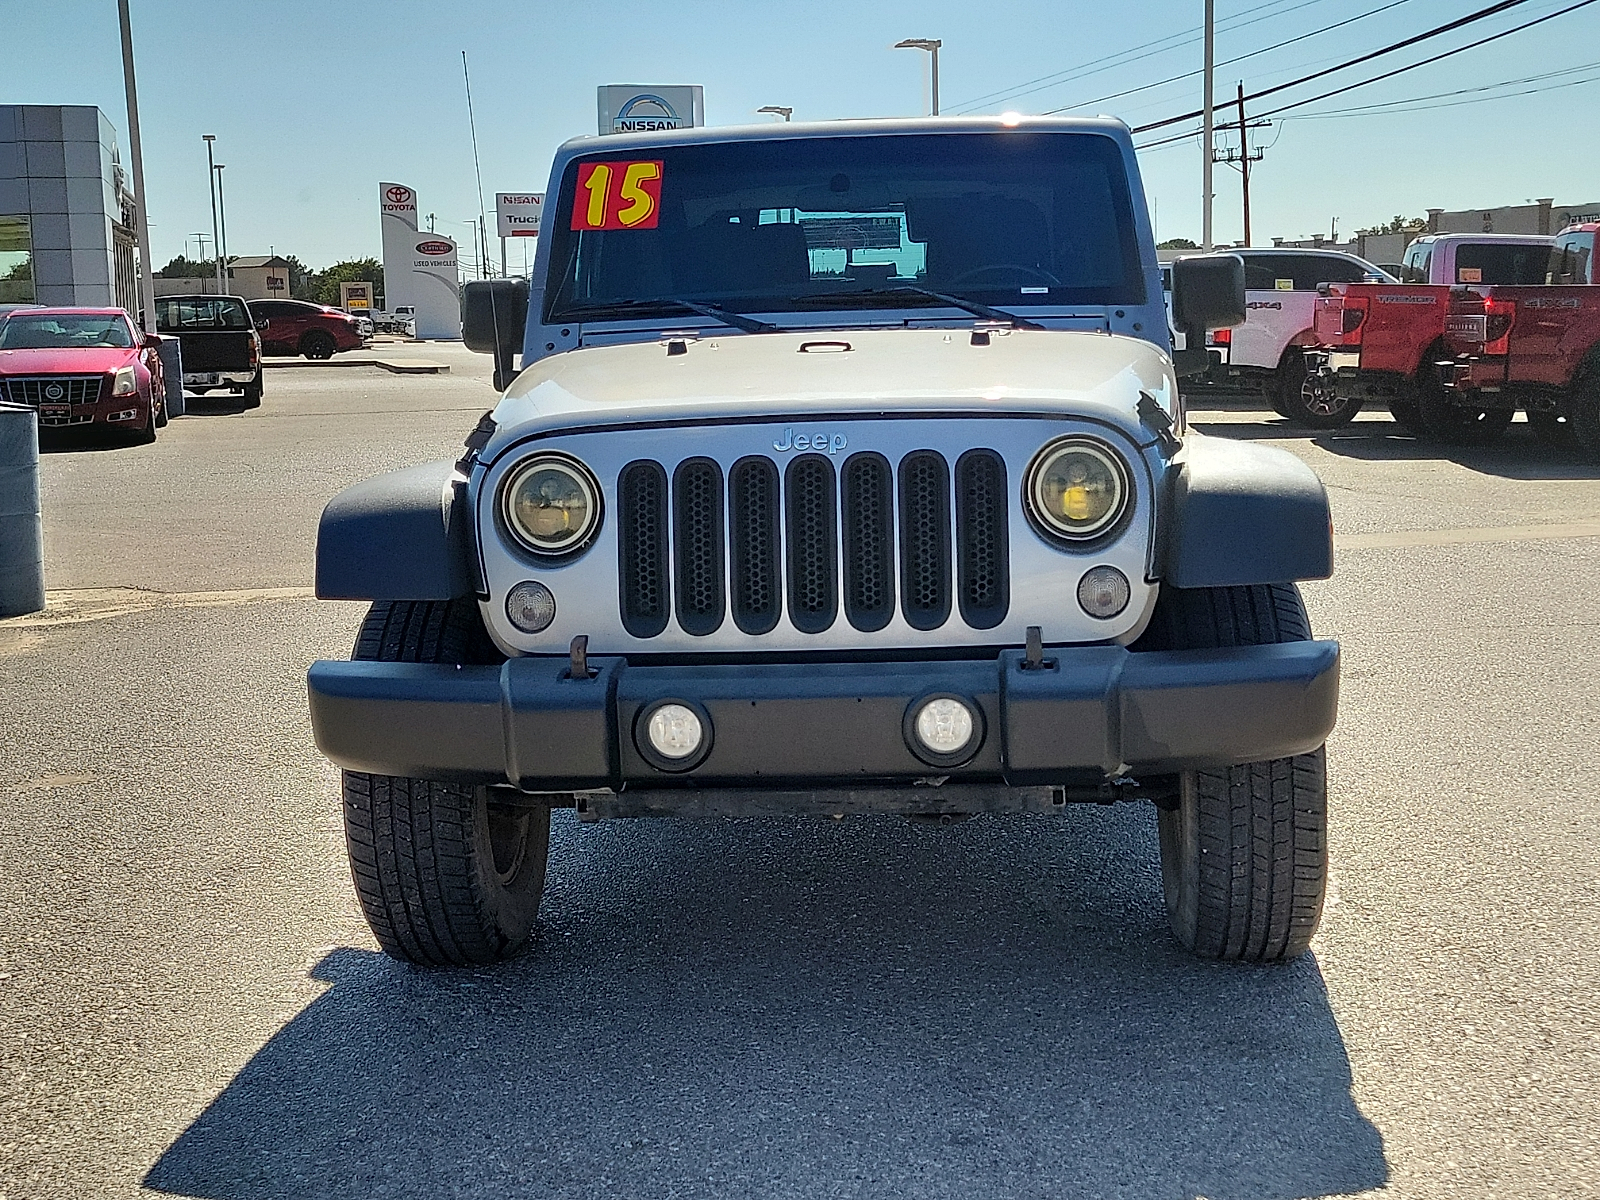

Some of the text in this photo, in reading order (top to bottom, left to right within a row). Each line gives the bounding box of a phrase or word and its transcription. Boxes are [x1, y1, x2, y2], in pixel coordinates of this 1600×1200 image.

[621, 120, 677, 131] NISSAN
[503, 195, 540, 205] NISSAN
[584, 162, 660, 228] 15
[1376, 295, 1437, 305] TREMOR
[773, 427, 848, 455] Jeep
